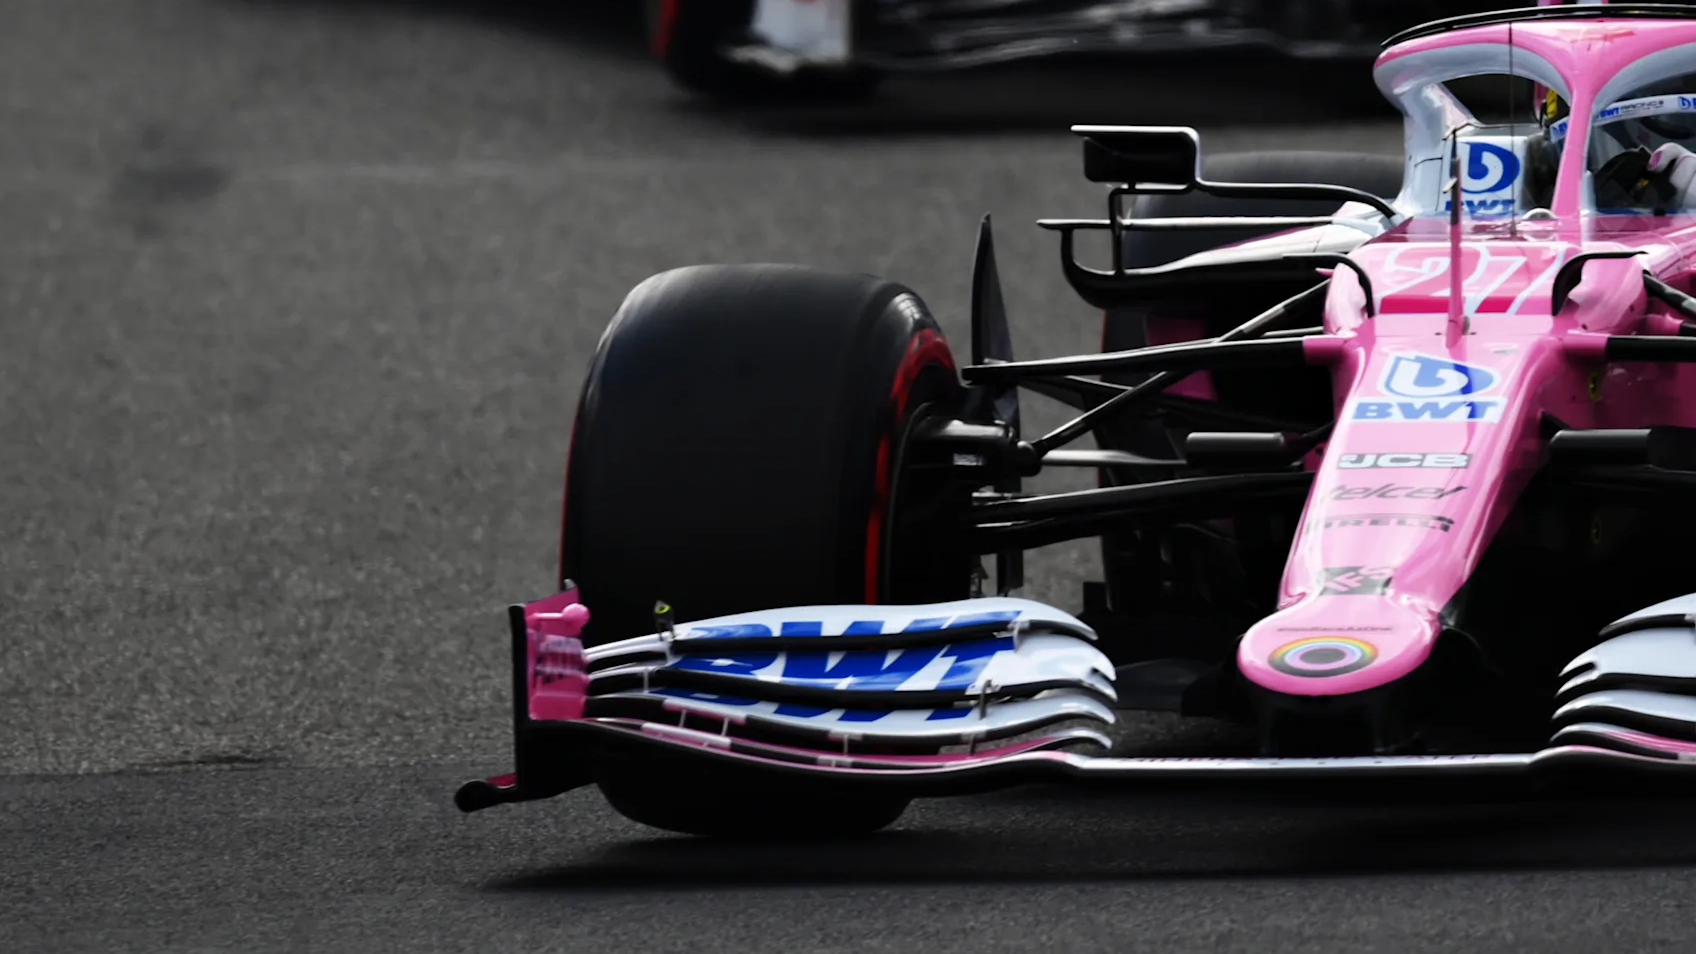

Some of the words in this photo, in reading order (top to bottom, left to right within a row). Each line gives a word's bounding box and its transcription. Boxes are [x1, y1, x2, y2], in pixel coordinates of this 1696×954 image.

[1352, 401, 1500, 421] BWT
[1338, 453, 1468, 469] JCB
[646, 609, 1023, 723] BWT
